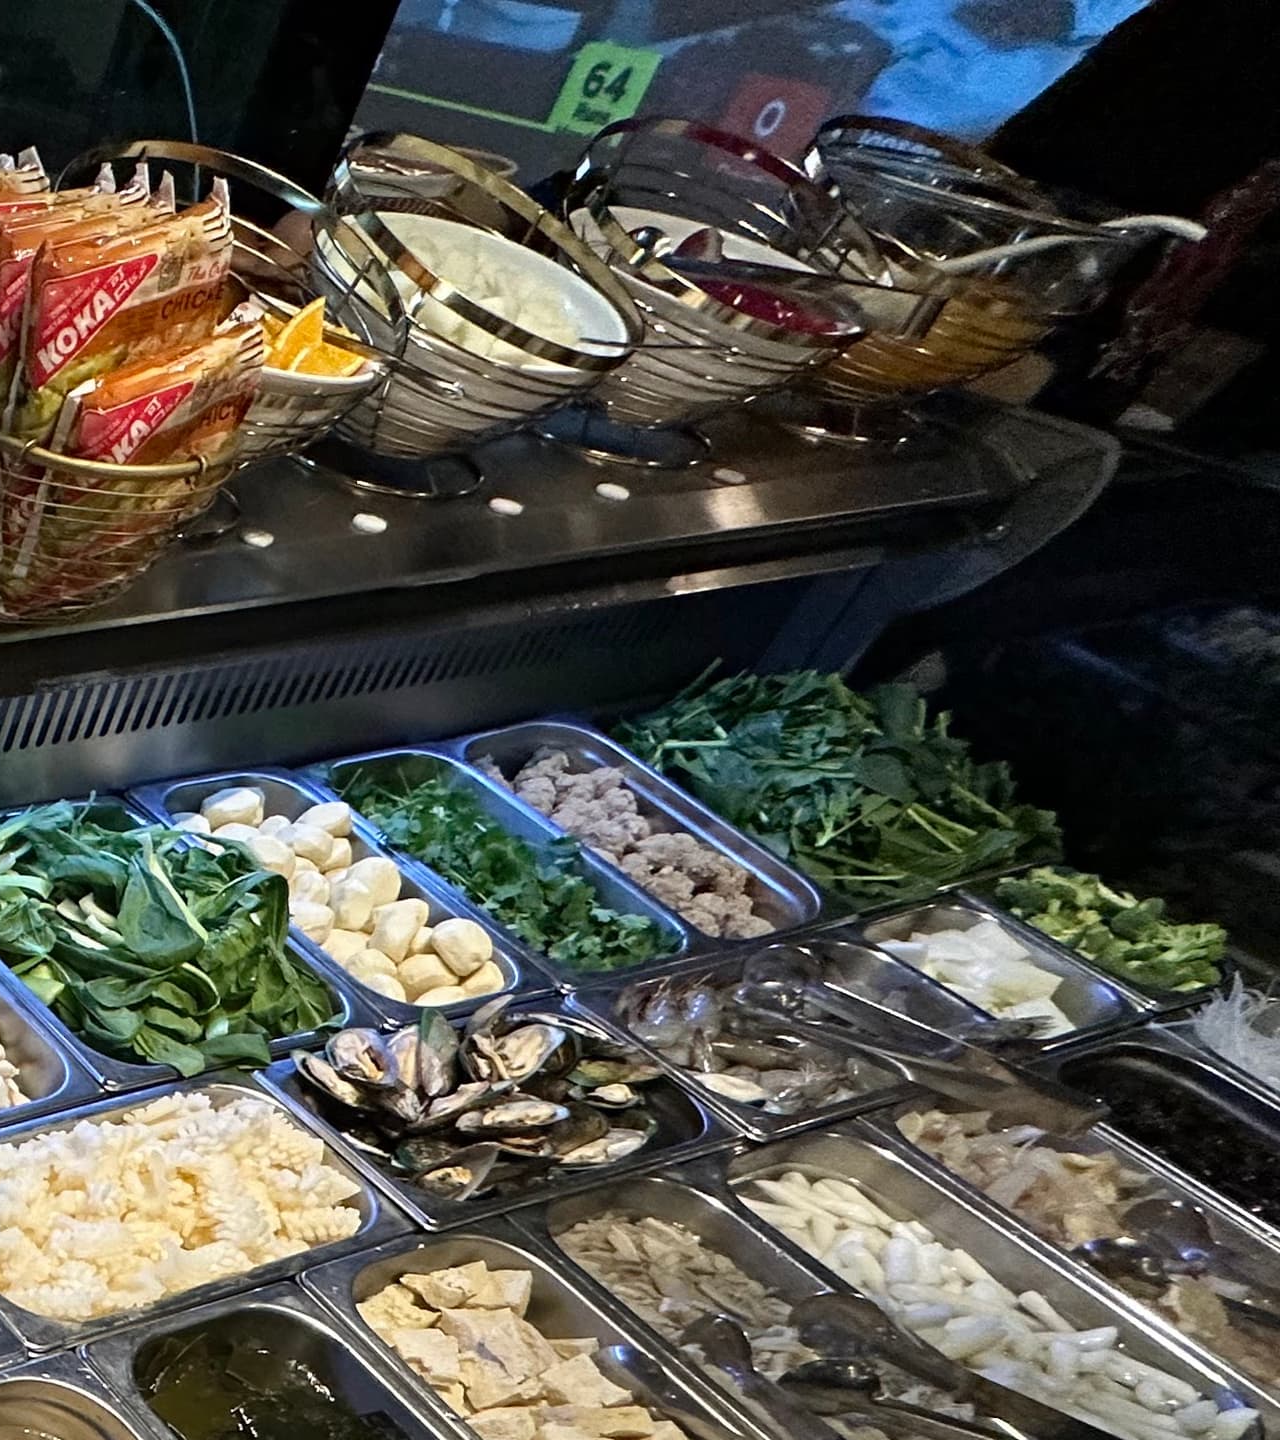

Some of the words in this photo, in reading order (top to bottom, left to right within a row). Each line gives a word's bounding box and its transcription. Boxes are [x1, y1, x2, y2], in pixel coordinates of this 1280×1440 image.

[582, 61, 633, 103] 64
[161, 283, 225, 320] CHICKE
[36, 288, 117, 374] KOKA
